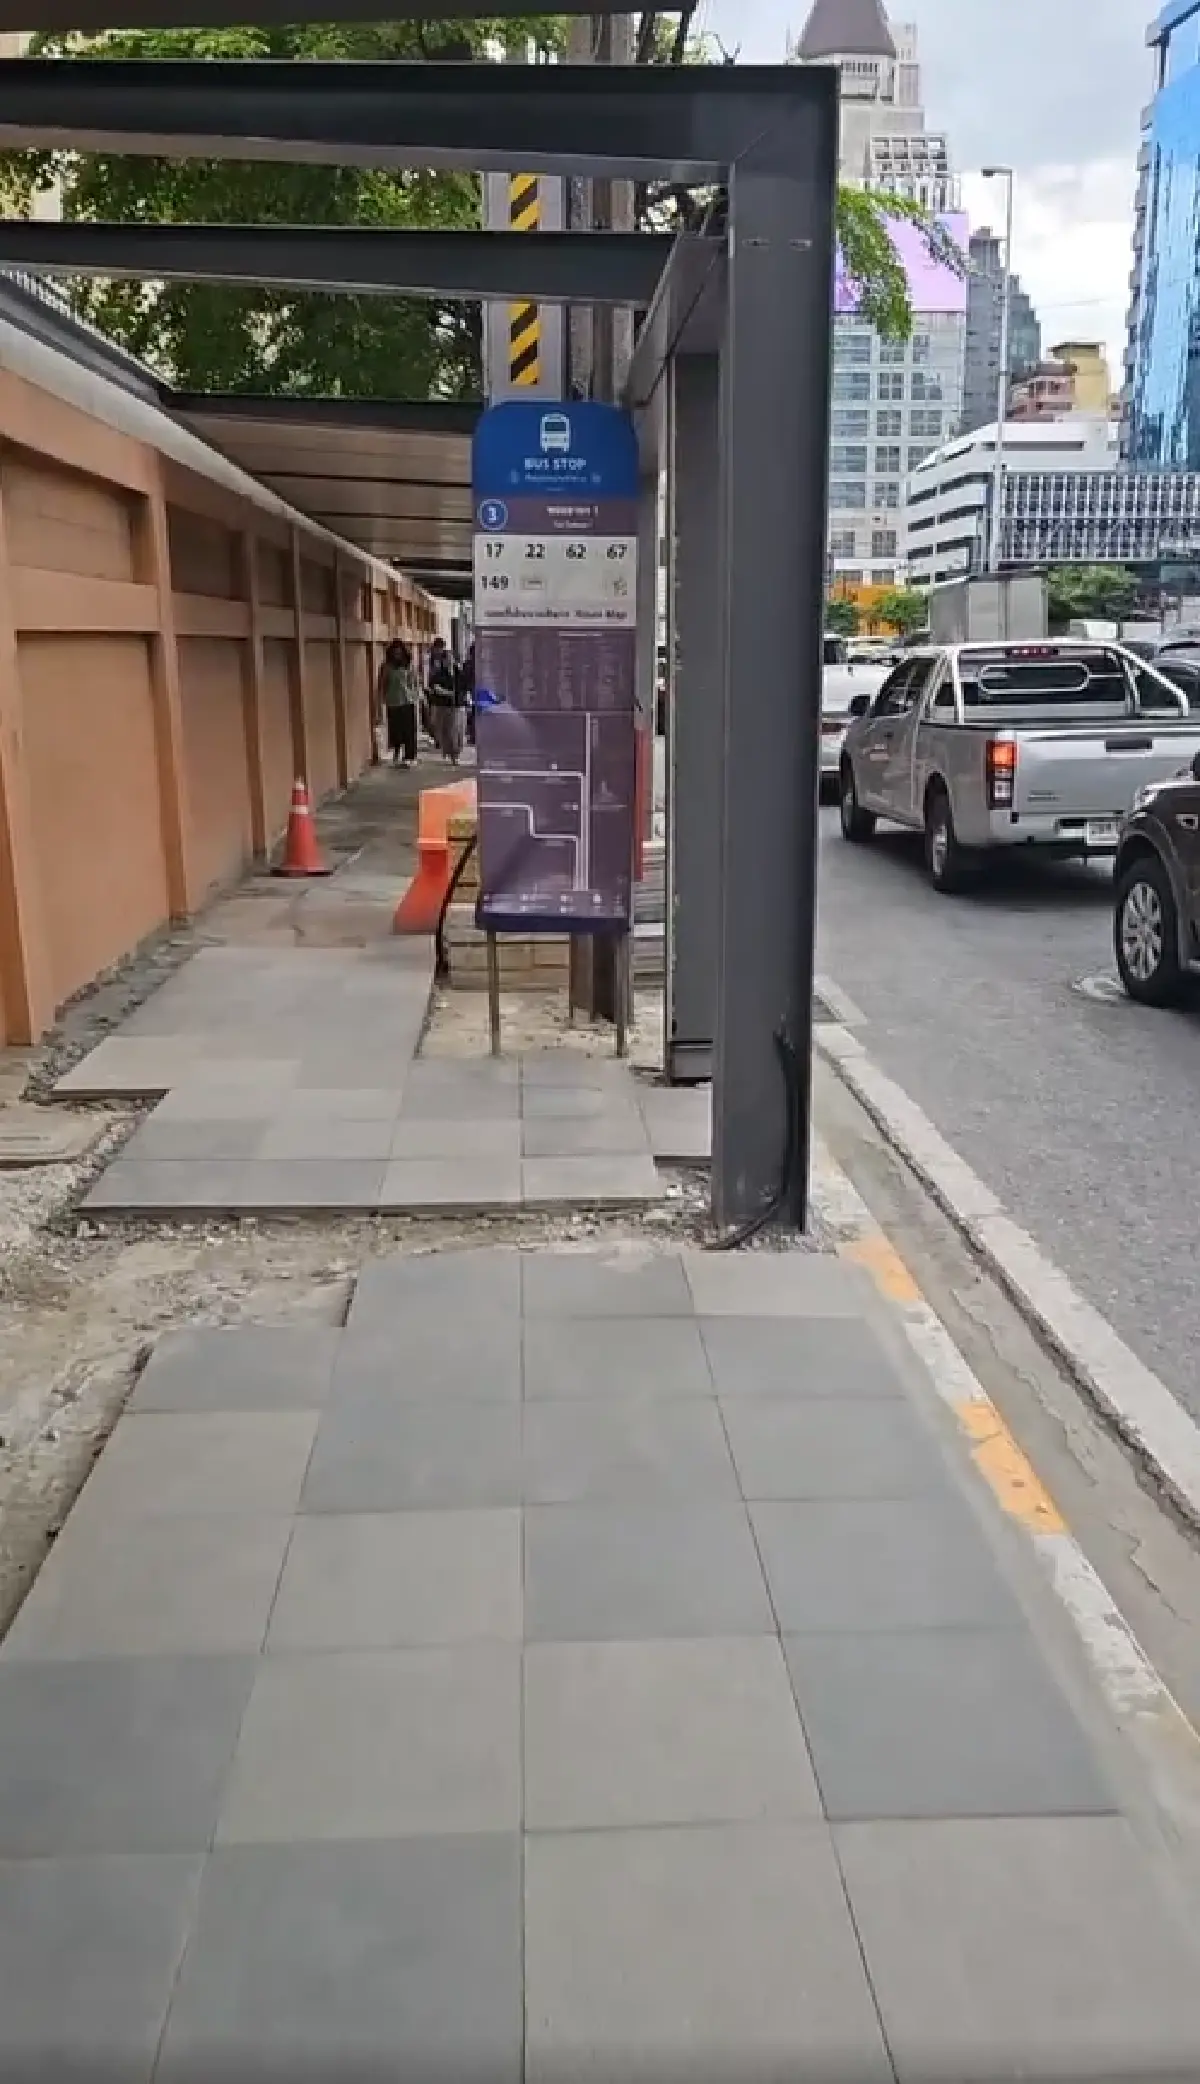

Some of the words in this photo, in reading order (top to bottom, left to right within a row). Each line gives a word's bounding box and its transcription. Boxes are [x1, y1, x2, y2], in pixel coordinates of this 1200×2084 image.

[524, 458, 550, 470] BUS
[554, 458, 586, 470] STOP
[488, 507, 497, 521] 3
[486, 543, 504, 558] 17
[525, 543, 545, 559] 22
[566, 543, 587, 559] 62
[607, 543, 628, 559] 67
[482, 575, 508, 590] 149
